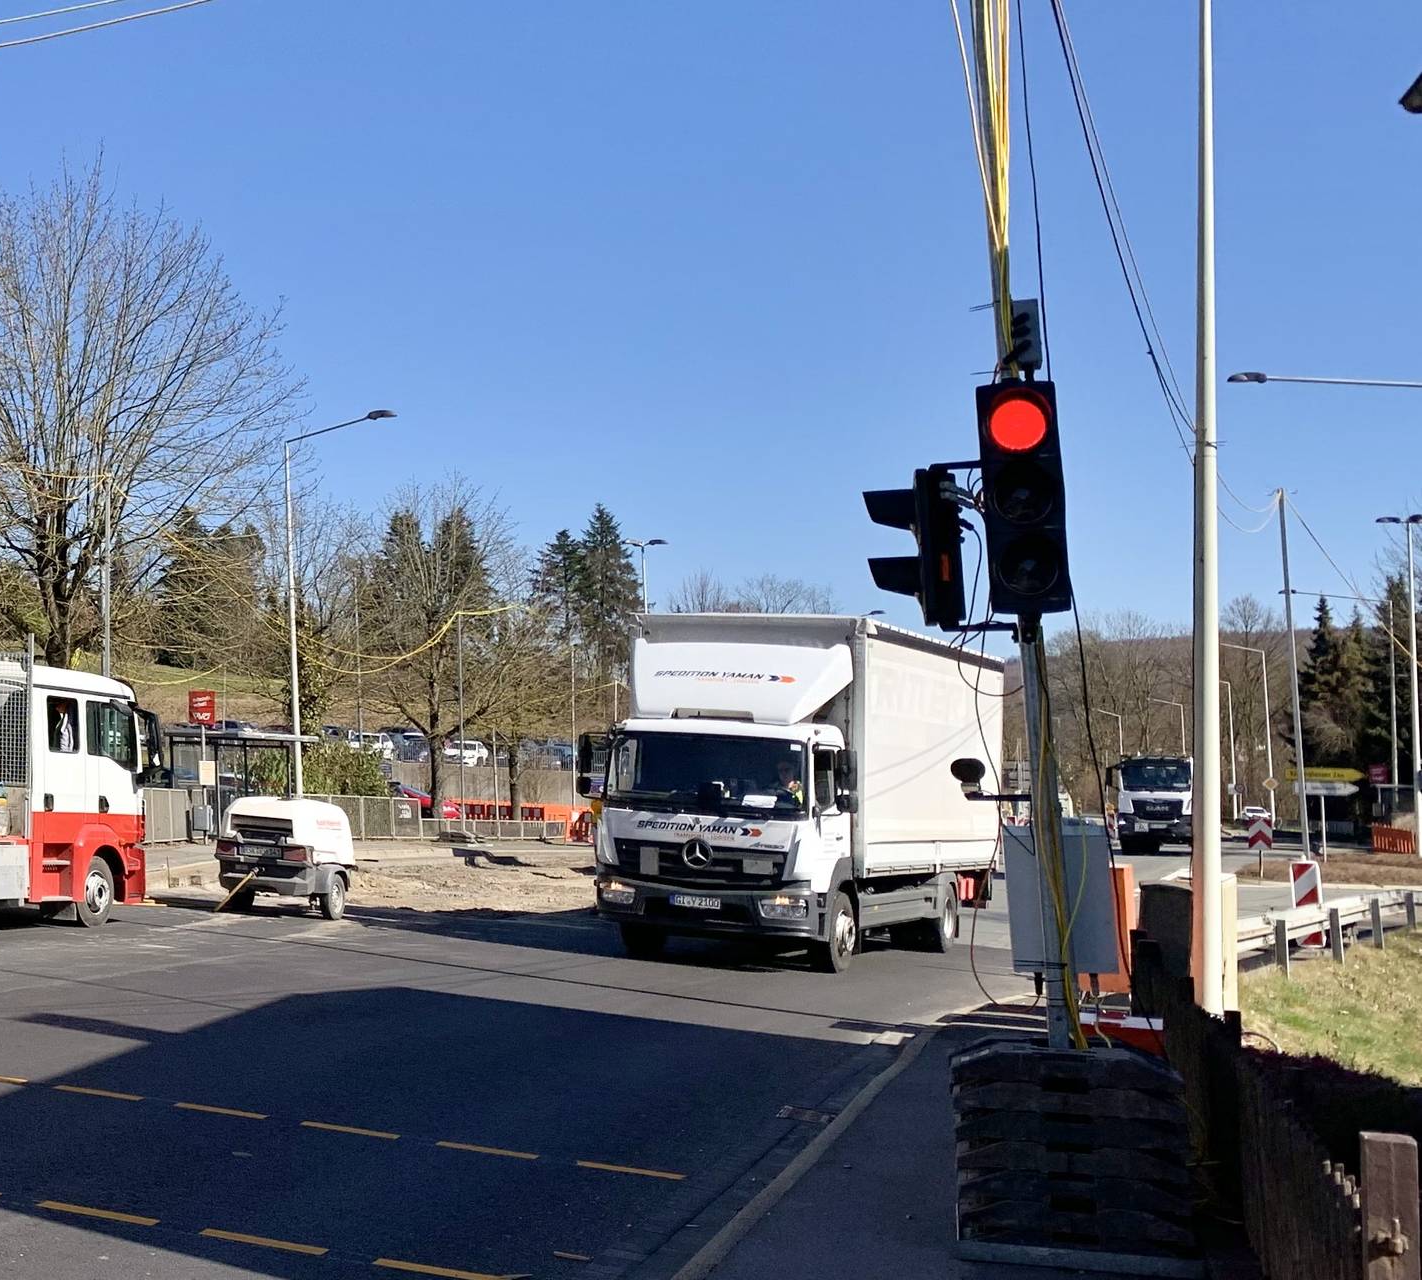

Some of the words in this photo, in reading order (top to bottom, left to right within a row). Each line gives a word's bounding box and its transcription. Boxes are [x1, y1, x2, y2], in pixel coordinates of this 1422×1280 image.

[721, 671, 765, 680] YAMAN
[636, 820, 697, 831] SPEDITION
[699, 824, 738, 835] YAMAN
